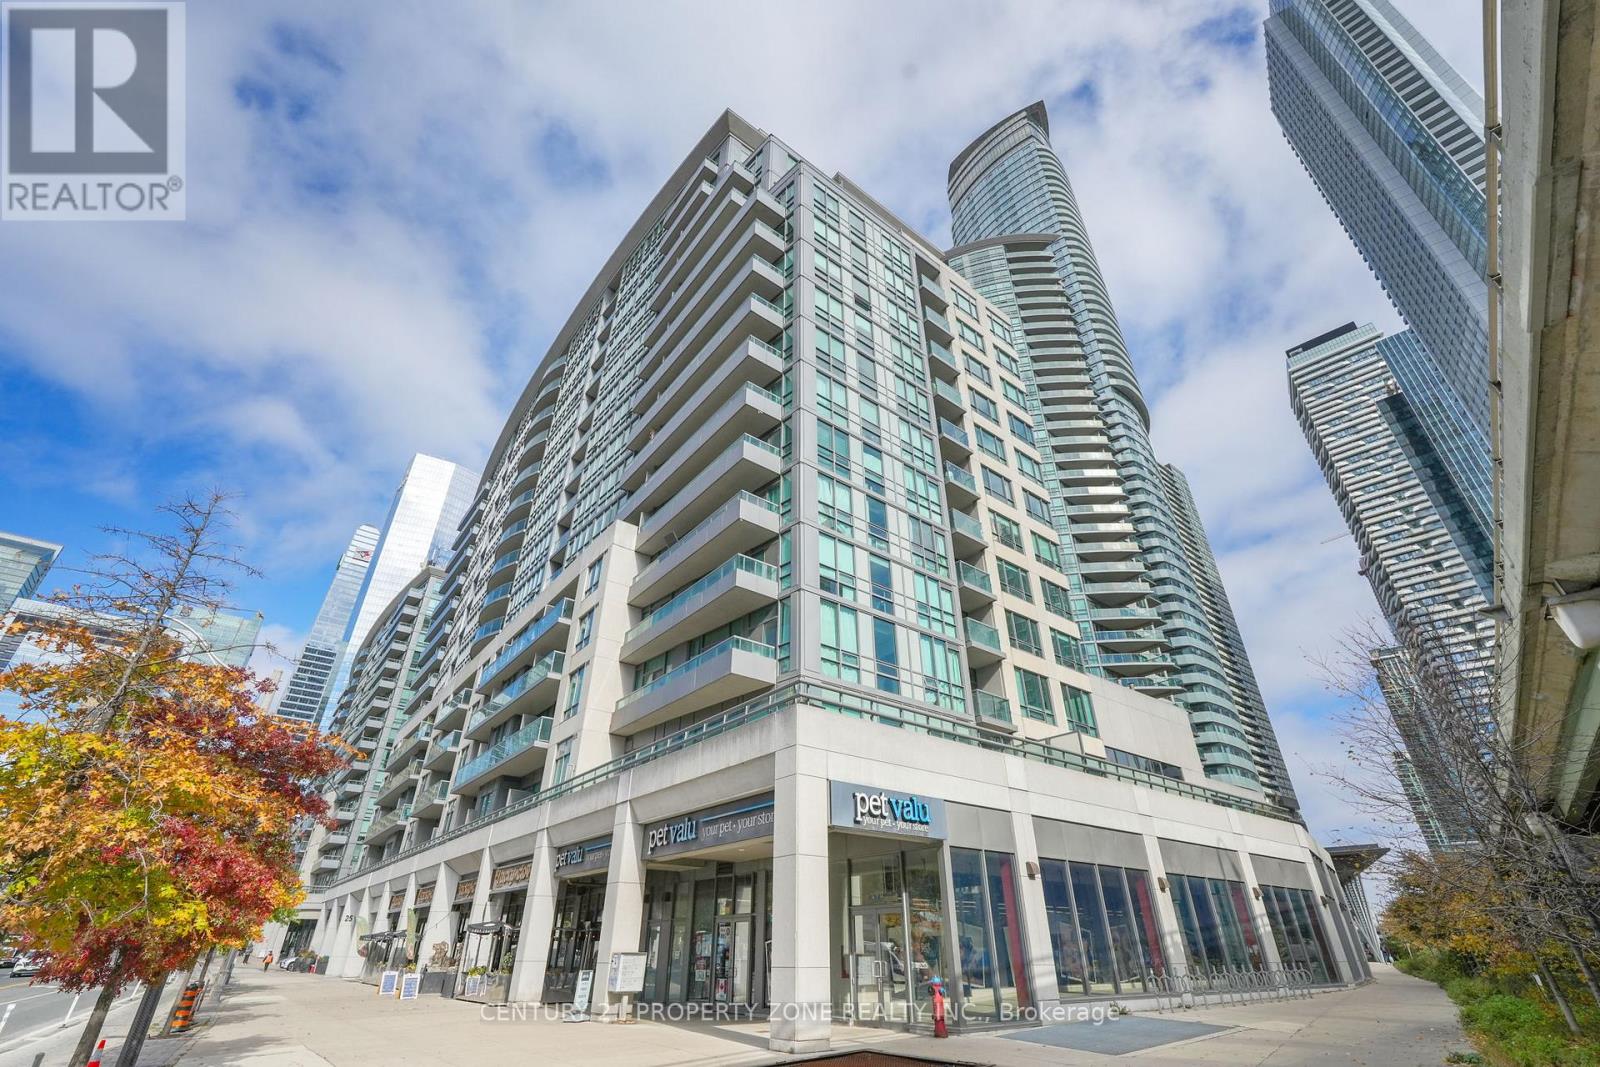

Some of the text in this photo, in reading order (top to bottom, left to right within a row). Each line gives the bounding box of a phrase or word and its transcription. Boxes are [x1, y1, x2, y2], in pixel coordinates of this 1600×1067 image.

[854, 791, 931, 824] pet valu
[862, 815, 880, 826] your
[647, 824, 668, 855] pet
[670, 817, 697, 844] valu
[702, 824, 719, 841] your
[719, 819, 733, 837] pet
[736, 815, 757, 834] your
[555, 851, 568, 873] pet
[567, 846, 583, 864] valu
[344, 914, 354, 922] 25
